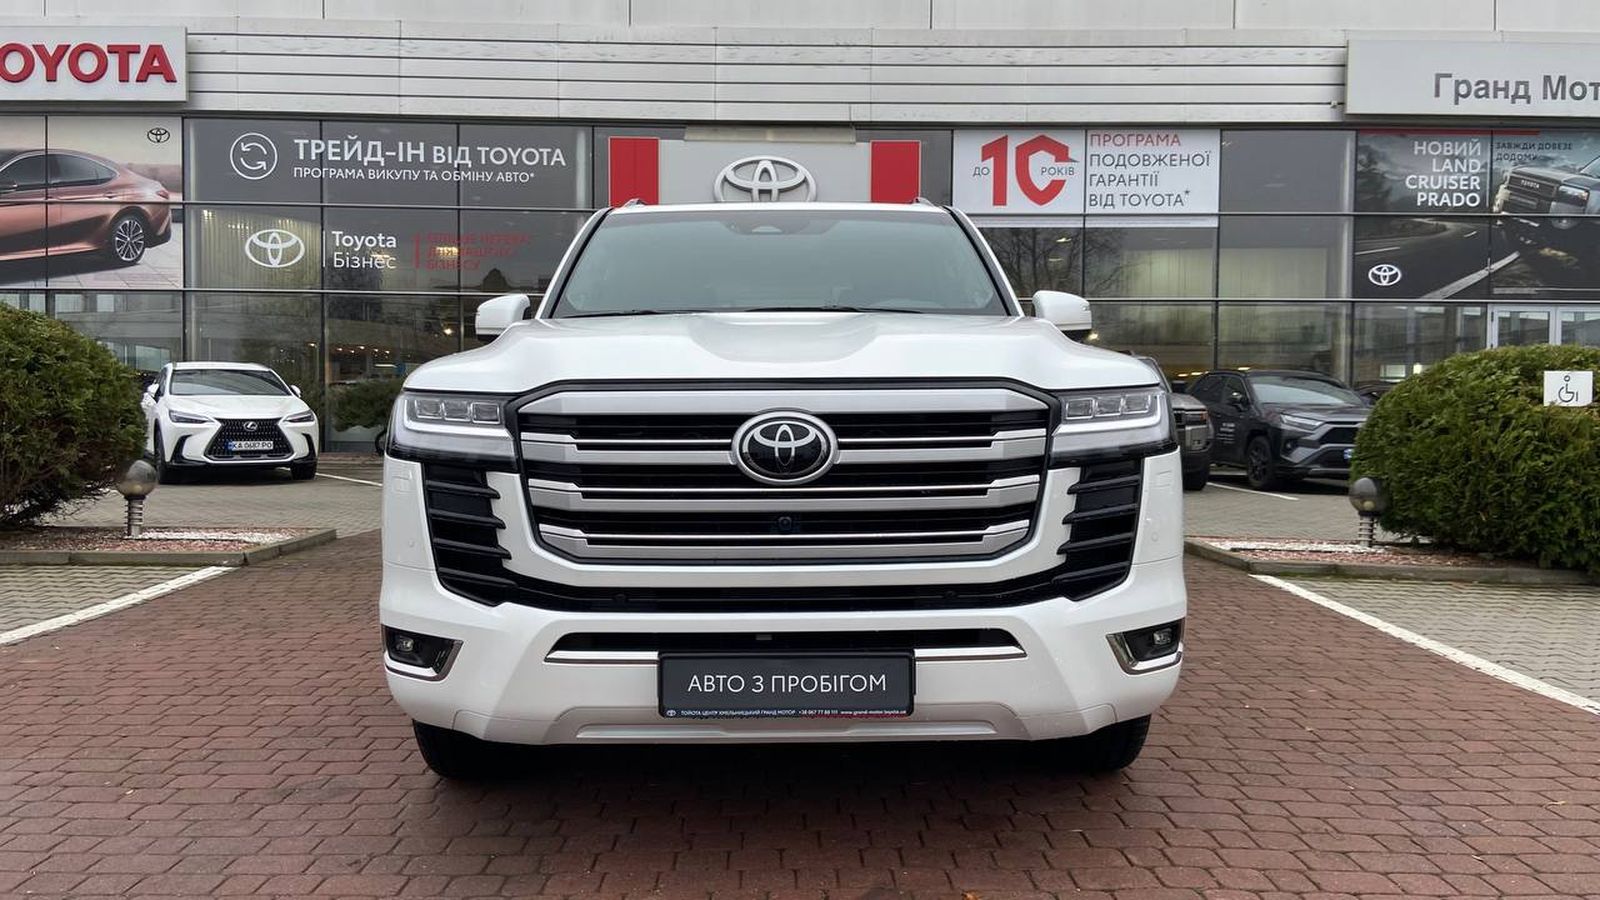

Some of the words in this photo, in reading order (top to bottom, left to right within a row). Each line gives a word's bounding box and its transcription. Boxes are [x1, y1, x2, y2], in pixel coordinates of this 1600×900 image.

[1434, 73, 1531, 105] Гранд
[1089, 134, 1181, 147] ПРОГРАМА
[1413, 138, 1481, 156] НОВИЙ
[294, 135, 425, 165] ТРЕЙД-ІН
[433, 145, 472, 167] ВІД
[477, 147, 566, 167] TOYOTA
[1089, 151, 1211, 169] ПОДОВЖЕНОЇ
[1432, 159, 1481, 173] LAND
[293, 167, 365, 181] ПРОГРАМА
[368, 169, 421, 181] ВИКУПУ
[423, 170, 438, 181] ТА
[441, 170, 494, 183] ОБМІНУ
[972, 167, 990, 177] ДО
[1040, 167, 1075, 176] РОКІВ
[1089, 171, 1160, 187] ГАРАНТІЇ
[1405, 174, 1481, 190] CRUISER
[1089, 193, 1115, 208] ВІД
[1416, 192, 1481, 207] PRADO
[332, 231, 397, 250] Toyota
[333, 252, 397, 269] Бізнес
[687, 674, 745, 693] АВТО
[751, 674, 765, 693] З
[771, 674, 886, 693] ПРОБІГОМ
